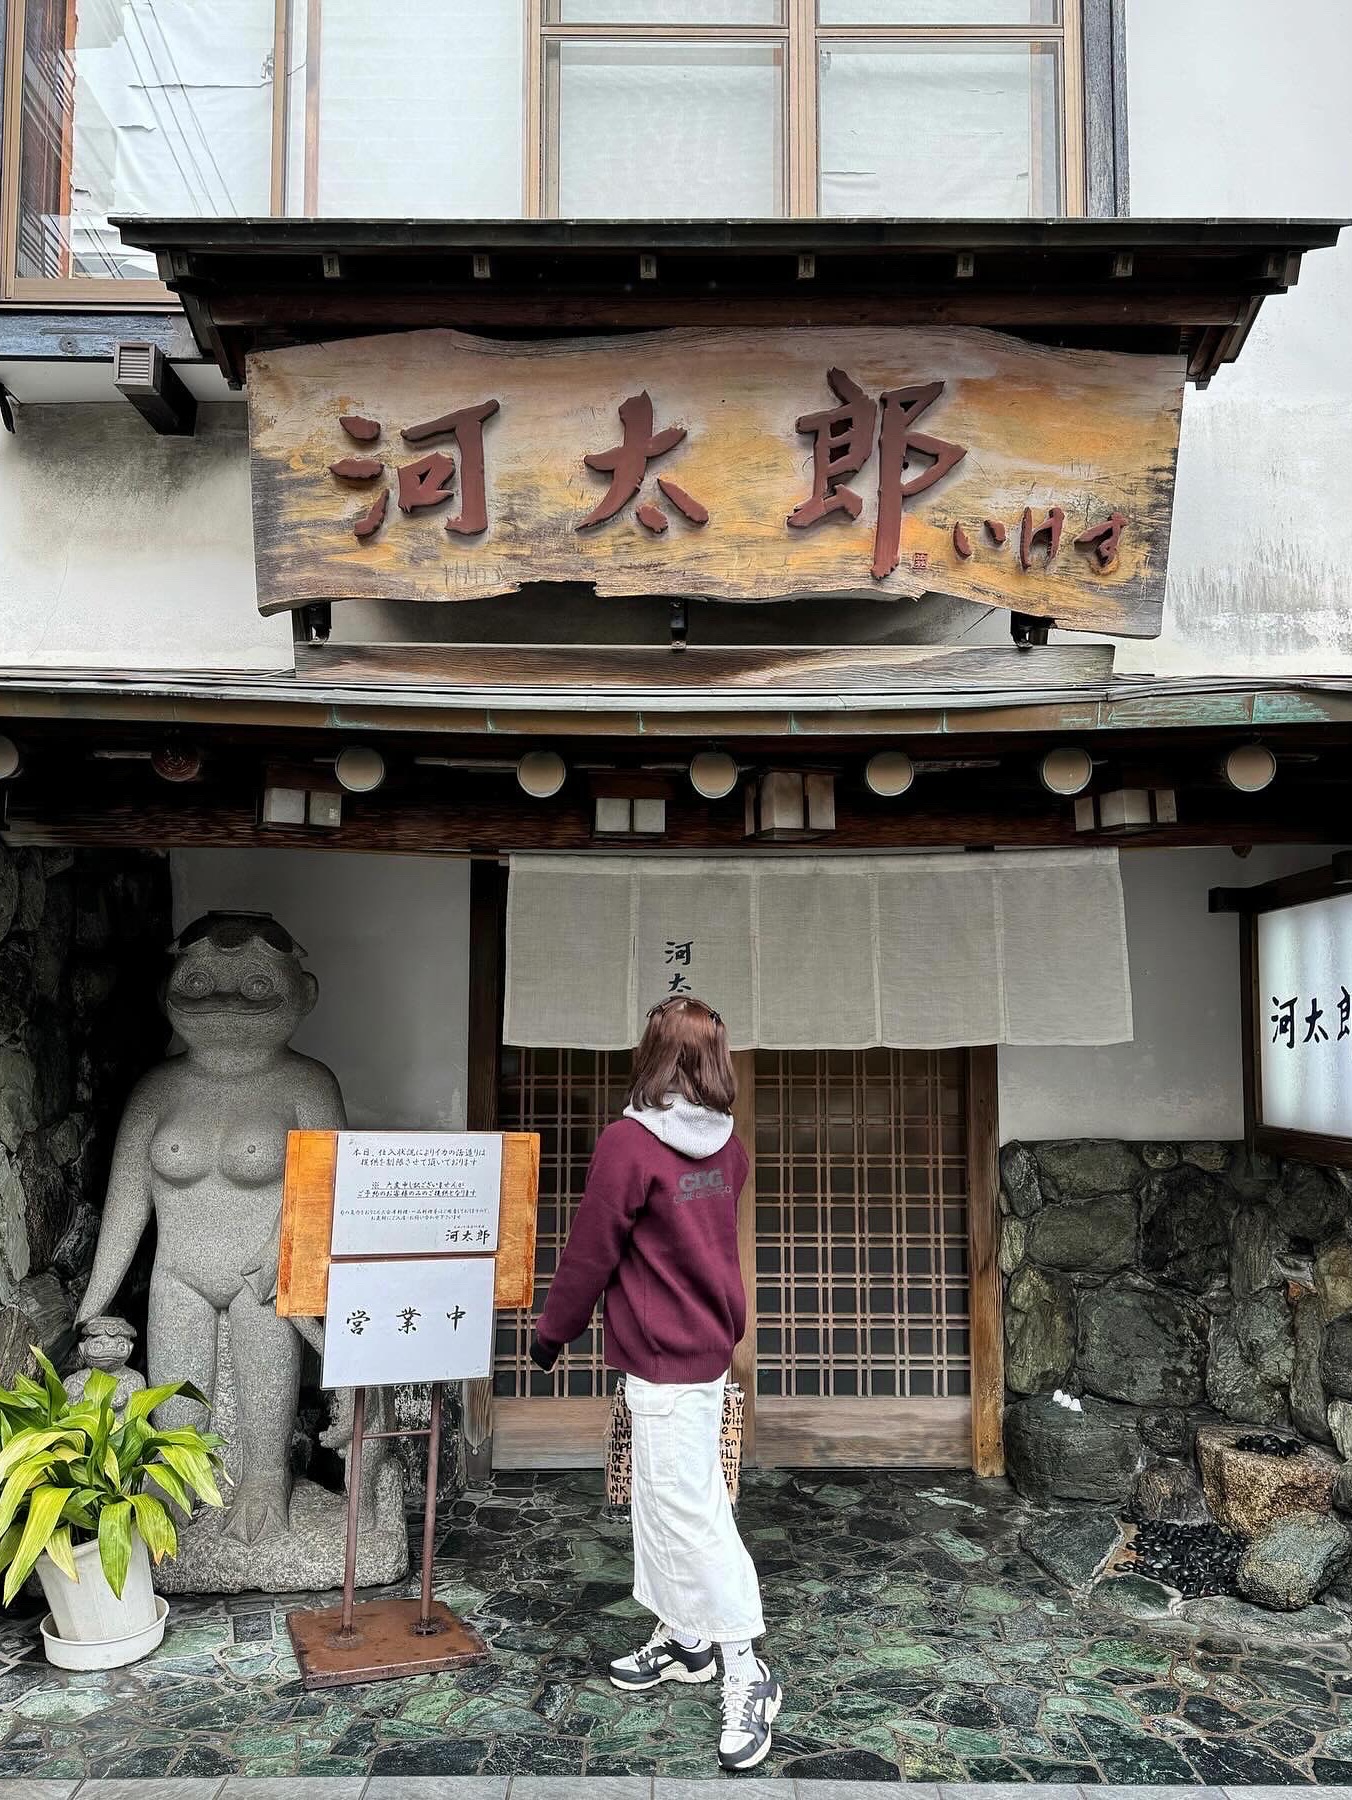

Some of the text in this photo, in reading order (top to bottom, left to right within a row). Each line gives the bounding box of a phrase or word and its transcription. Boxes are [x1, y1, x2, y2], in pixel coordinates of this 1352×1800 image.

[330, 366, 967, 578] 河太郎
[953, 506, 1129, 573] いけす
[445, 1229, 490, 1245] 河太郎
[346, 1305, 466, 1336] 営業中
